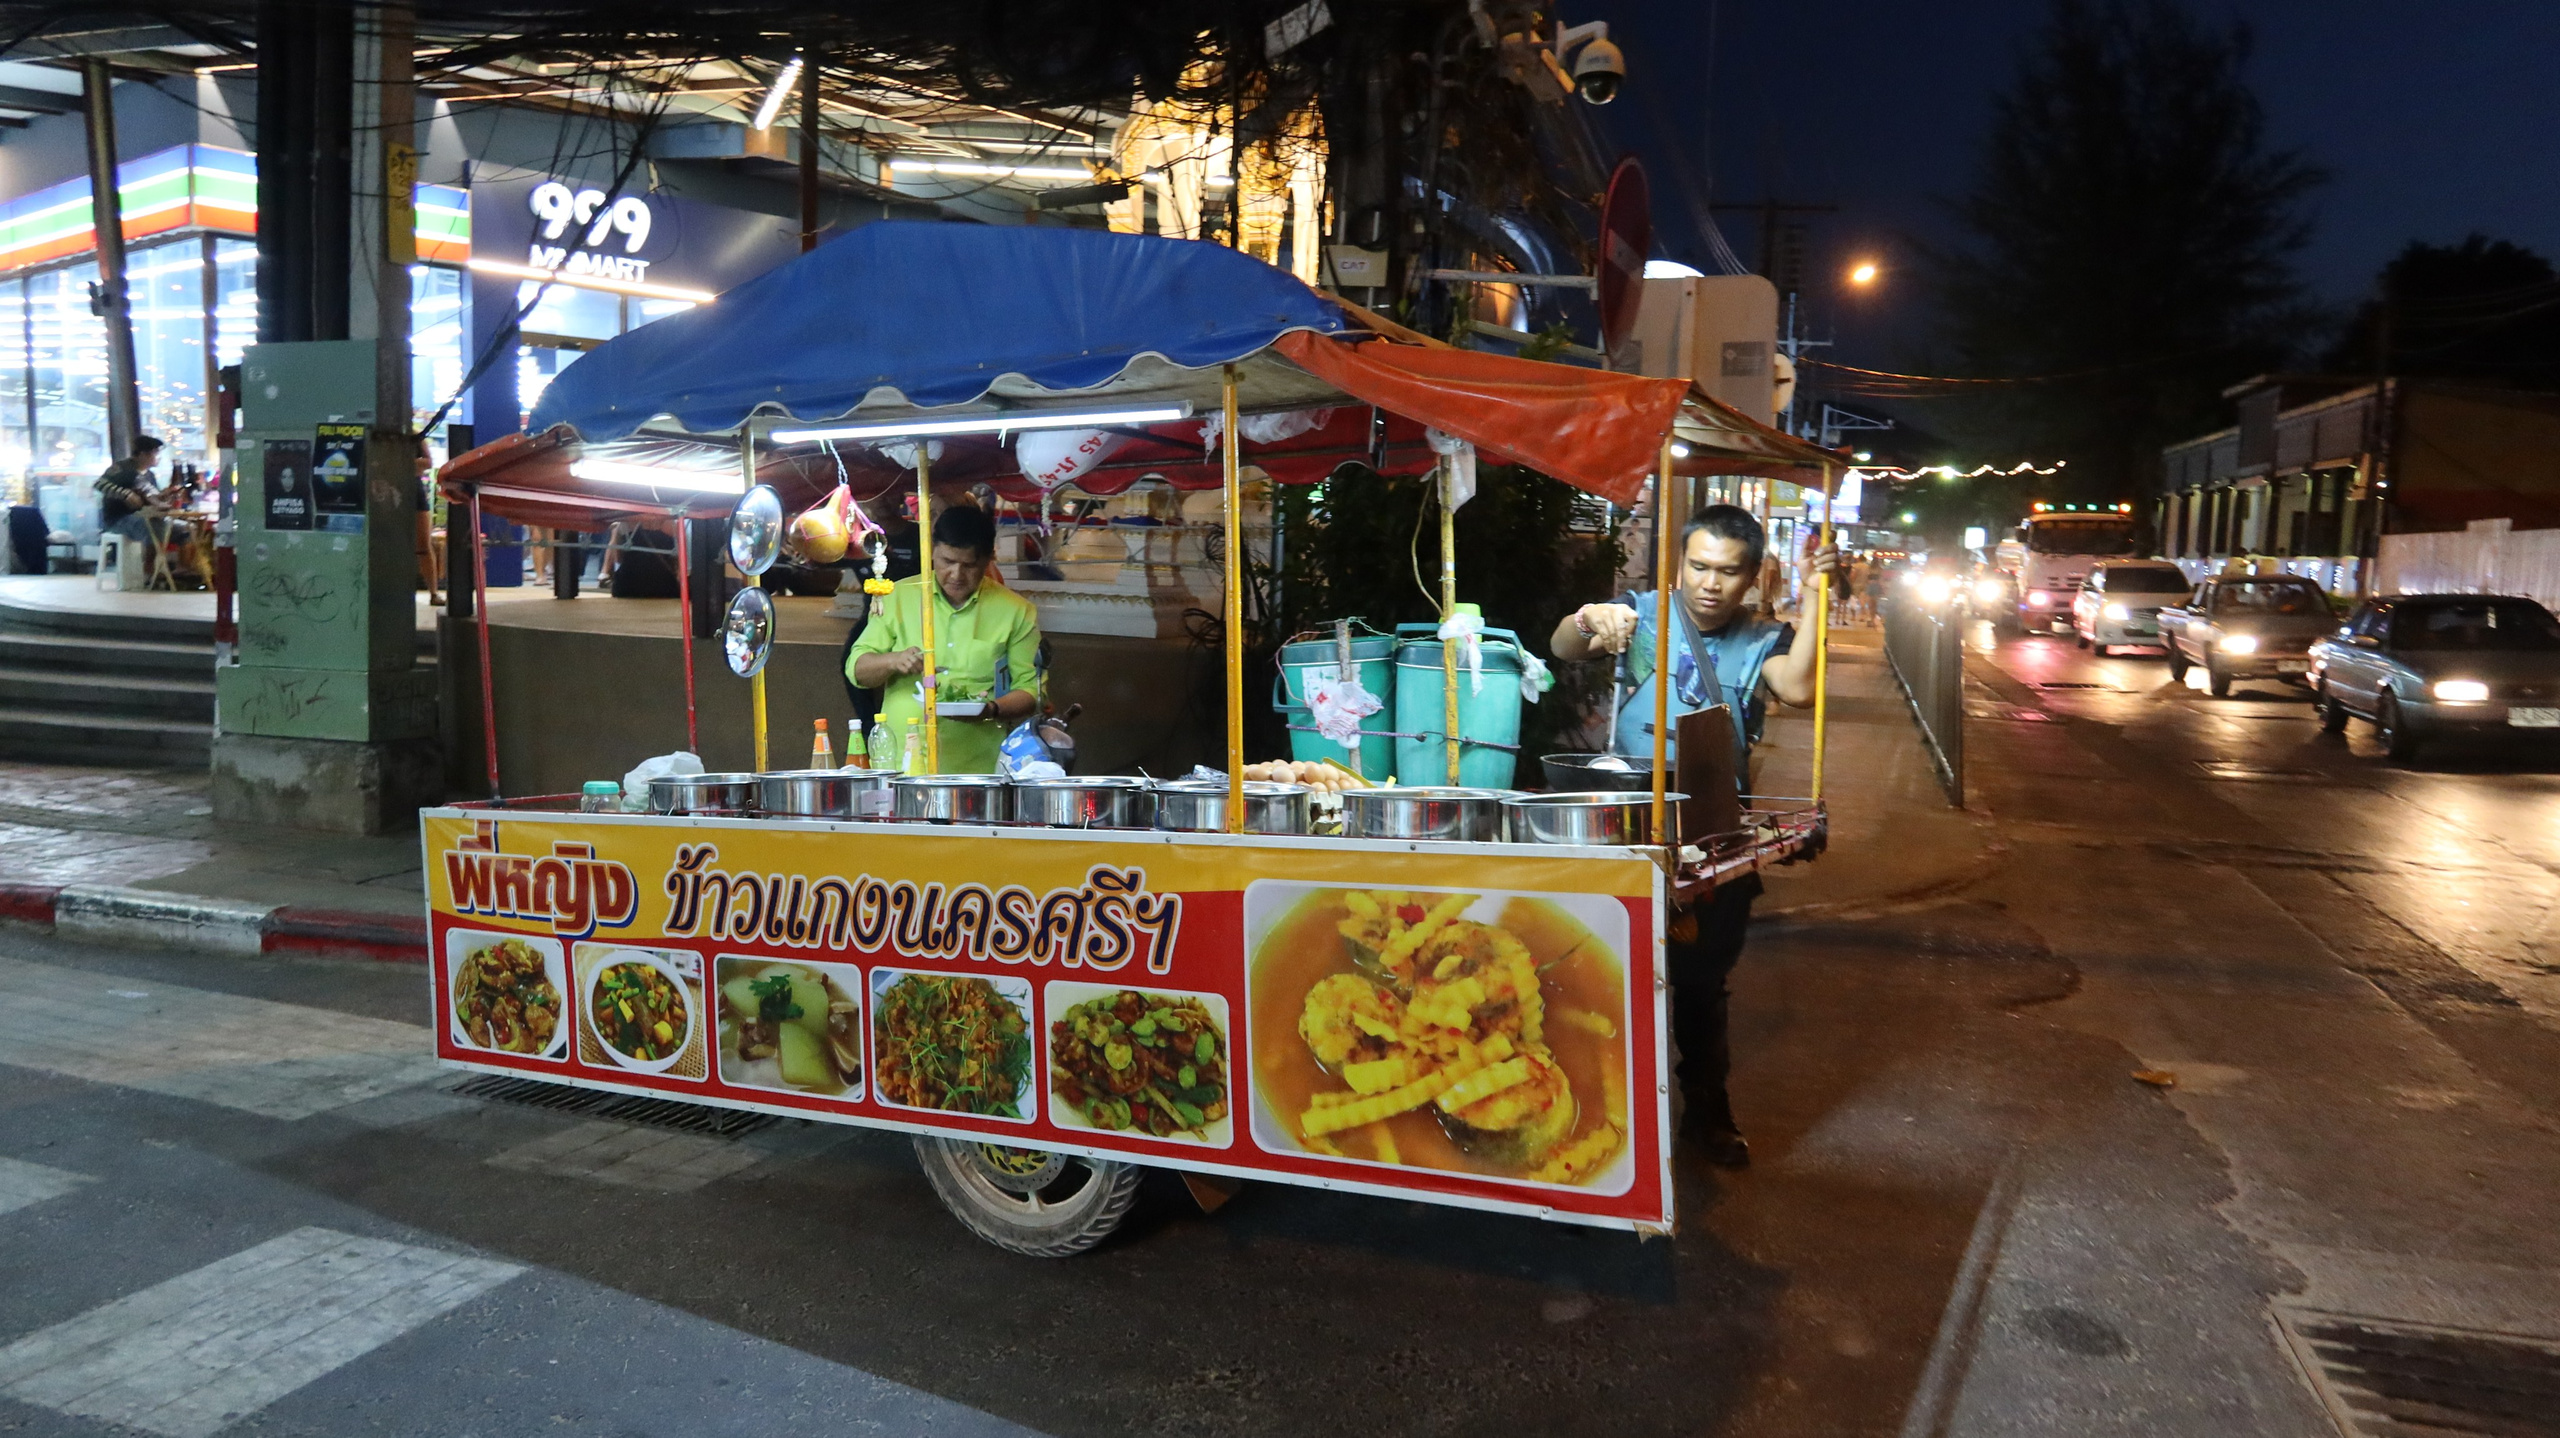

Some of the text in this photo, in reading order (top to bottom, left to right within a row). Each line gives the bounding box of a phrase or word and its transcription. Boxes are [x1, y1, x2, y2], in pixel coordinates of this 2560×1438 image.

[531, 182, 651, 253] 999
[444, 819, 1181, 973] พี่หญิง ข้าวแกงนครศรีฯ
